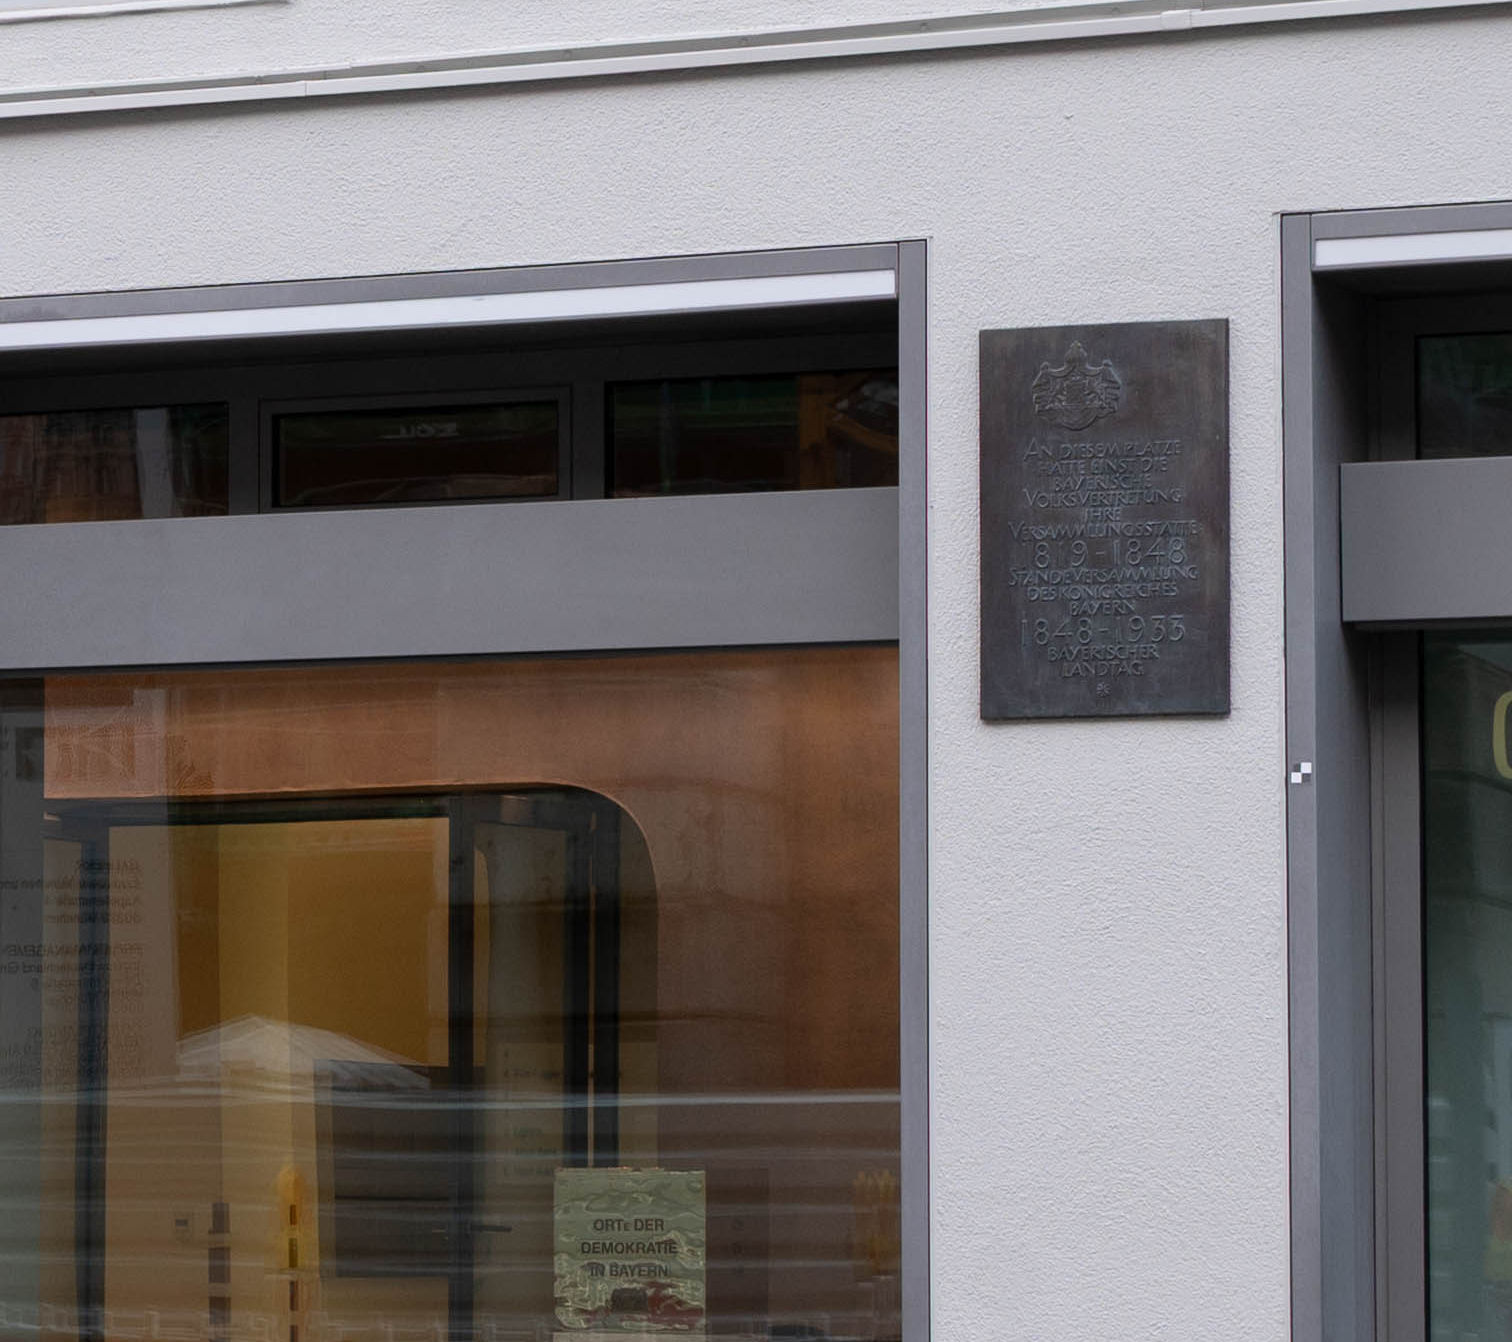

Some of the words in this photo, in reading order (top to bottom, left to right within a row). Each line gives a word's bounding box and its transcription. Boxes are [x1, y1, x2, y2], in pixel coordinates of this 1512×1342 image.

[1060, 443, 1121, 459] DIESEM
[1142, 456, 1169, 473] DIE
[1055, 473, 1153, 491] BAYERISCHE
[1070, 600, 1137, 616] BAYERN
[1047, 644, 1162, 662] BAYERISCHER
[1062, 661, 1145, 677] LANDTAG
[634, 1218, 665, 1232] DER
[581, 1241, 678, 1254] DEMOKRATIE
[589, 1263, 605, 1276] IN
[609, 1263, 668, 1277] BAYERN
